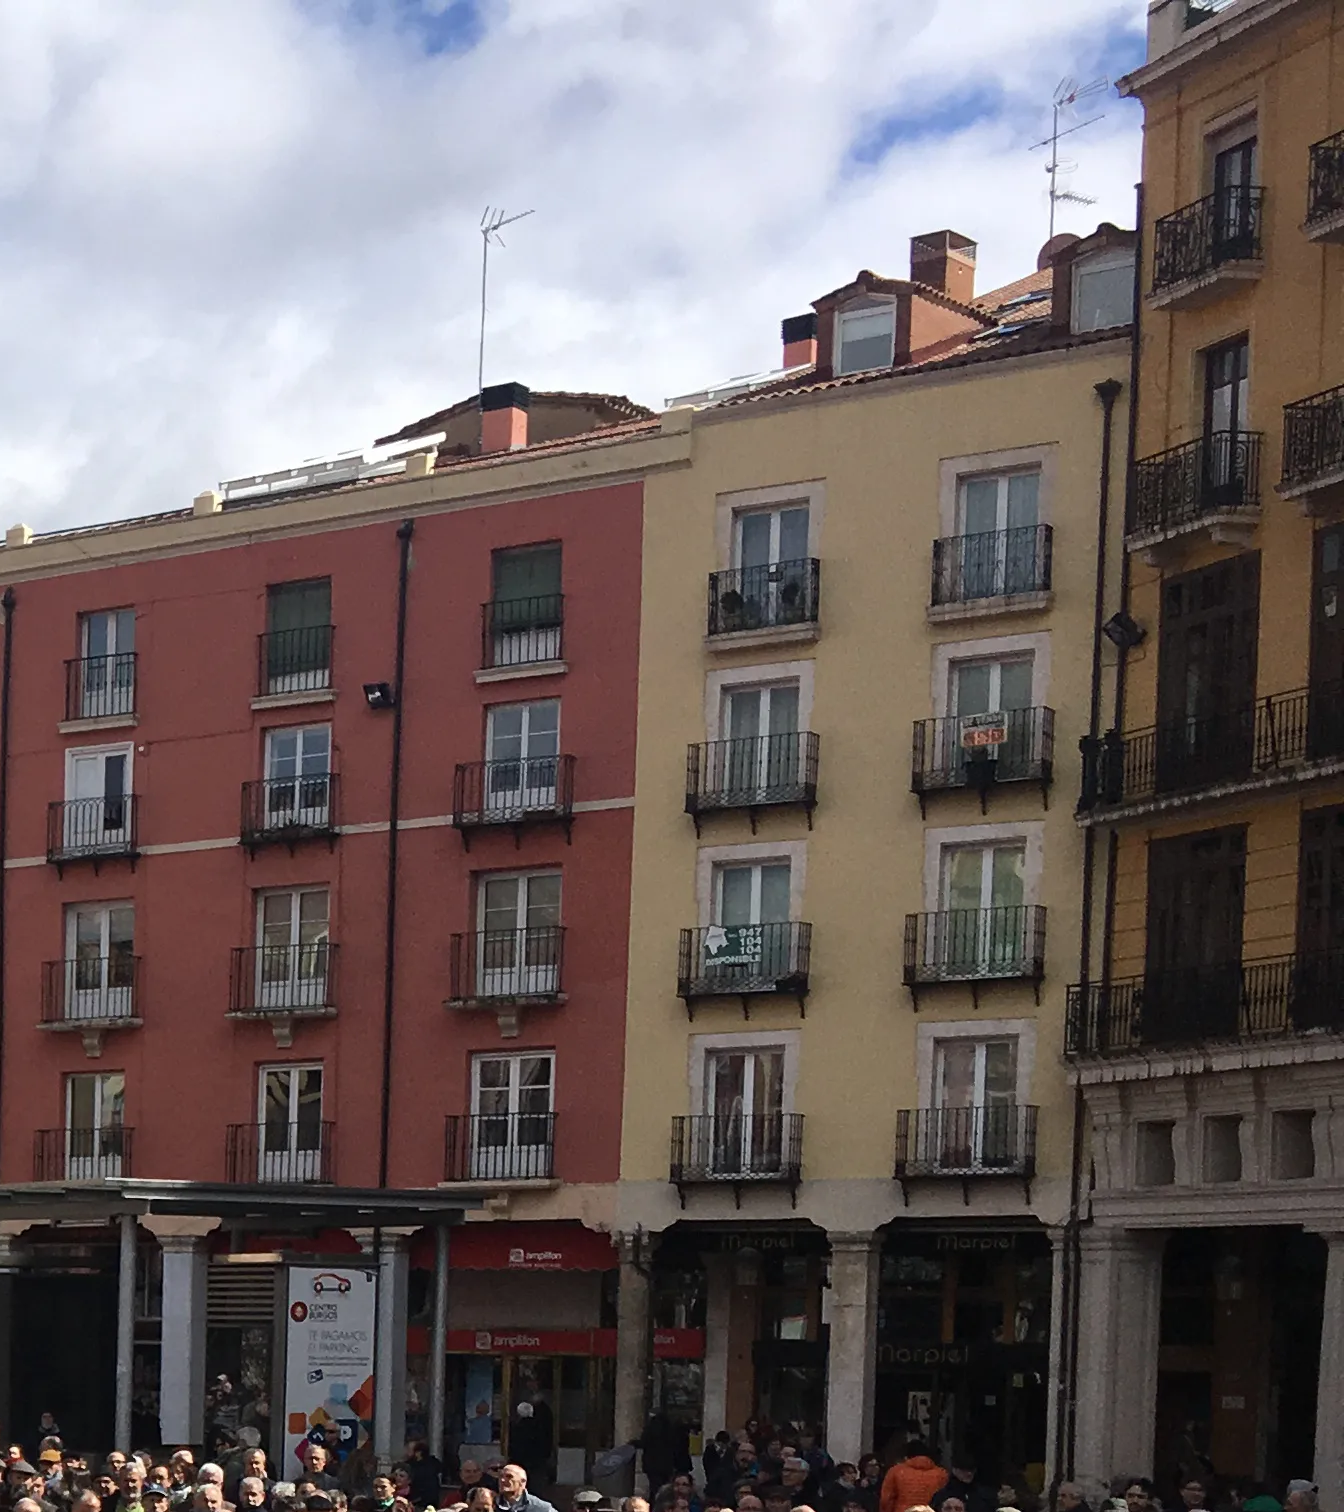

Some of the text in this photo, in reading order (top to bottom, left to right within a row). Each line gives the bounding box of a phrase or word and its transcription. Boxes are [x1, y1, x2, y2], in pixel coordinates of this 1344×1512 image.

[738, 927, 762, 937] 947
[739, 937, 762, 946] 104
[739, 945, 762, 955] 104
[705, 954, 762, 967] DISPONIBLE
[937, 1234, 1017, 1249] Marpiel
